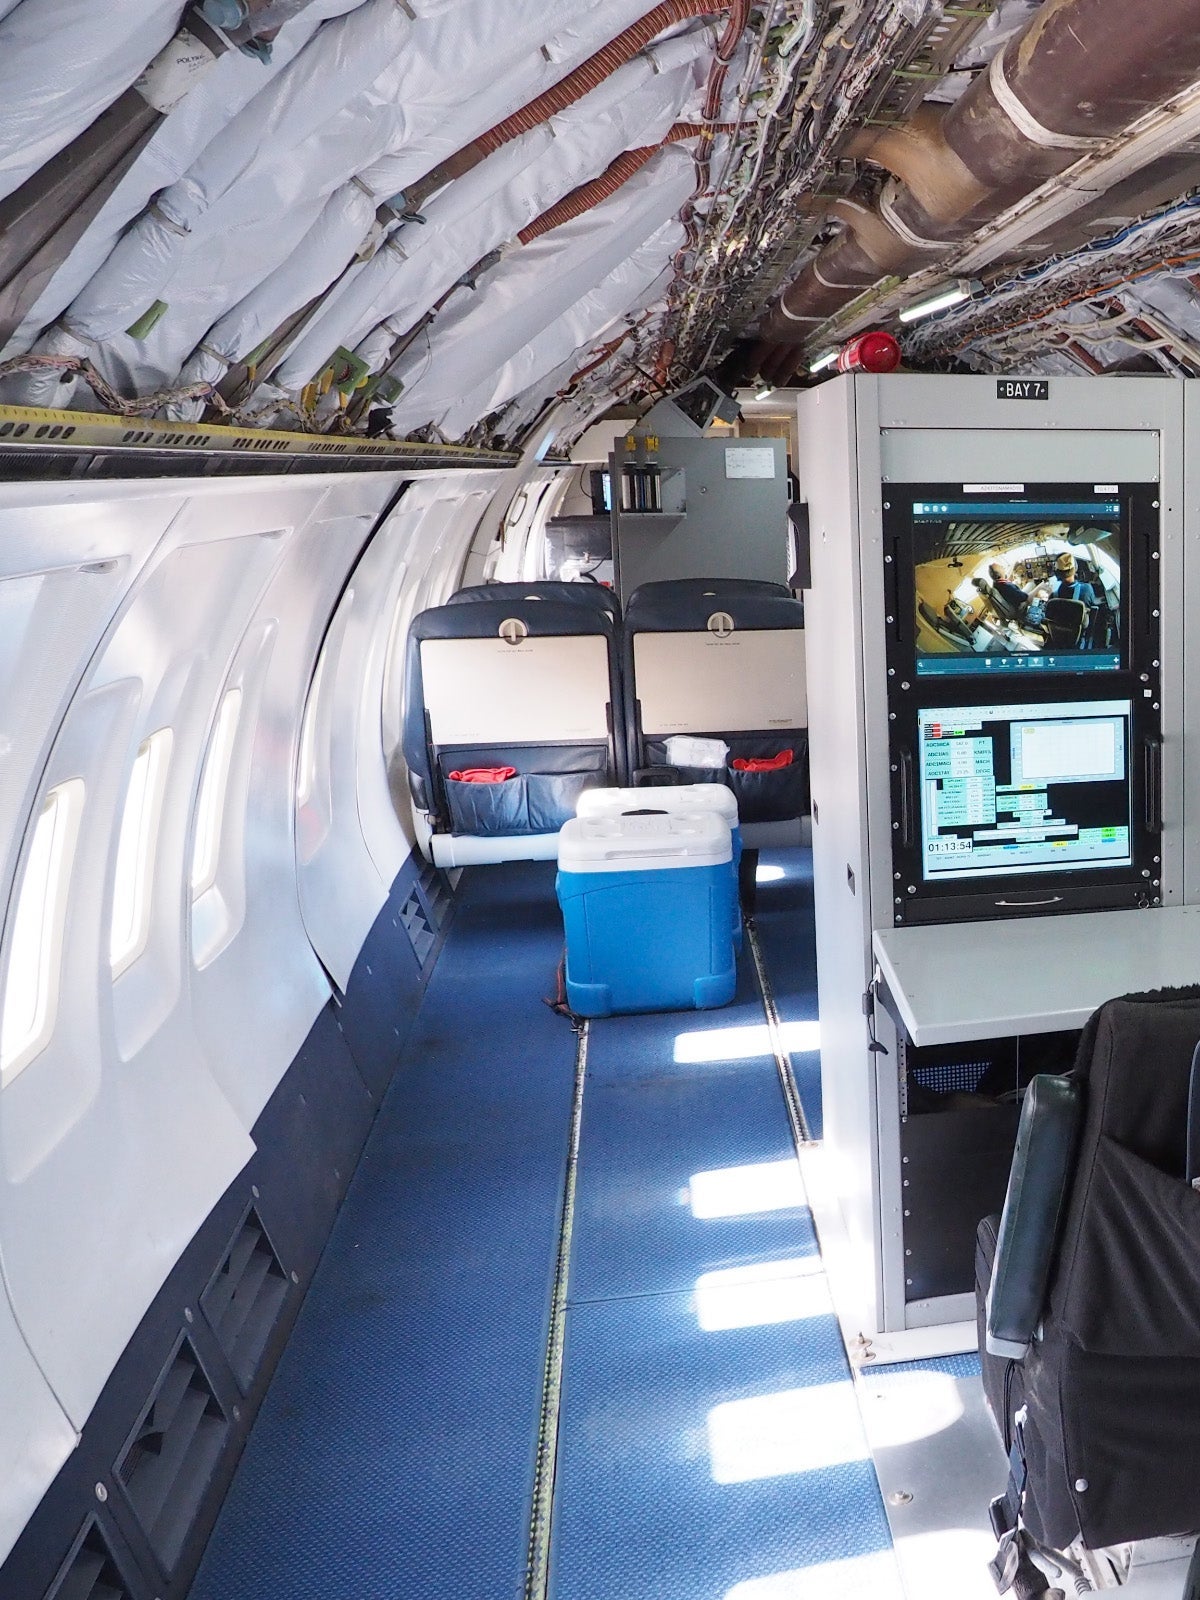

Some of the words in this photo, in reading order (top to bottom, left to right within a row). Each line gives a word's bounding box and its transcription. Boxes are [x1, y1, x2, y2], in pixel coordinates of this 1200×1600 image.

[1006, 382, 1031, 397] BAY
[1034, 382, 1041, 398] 7
[928, 841, 972, 852] 01:13:54
